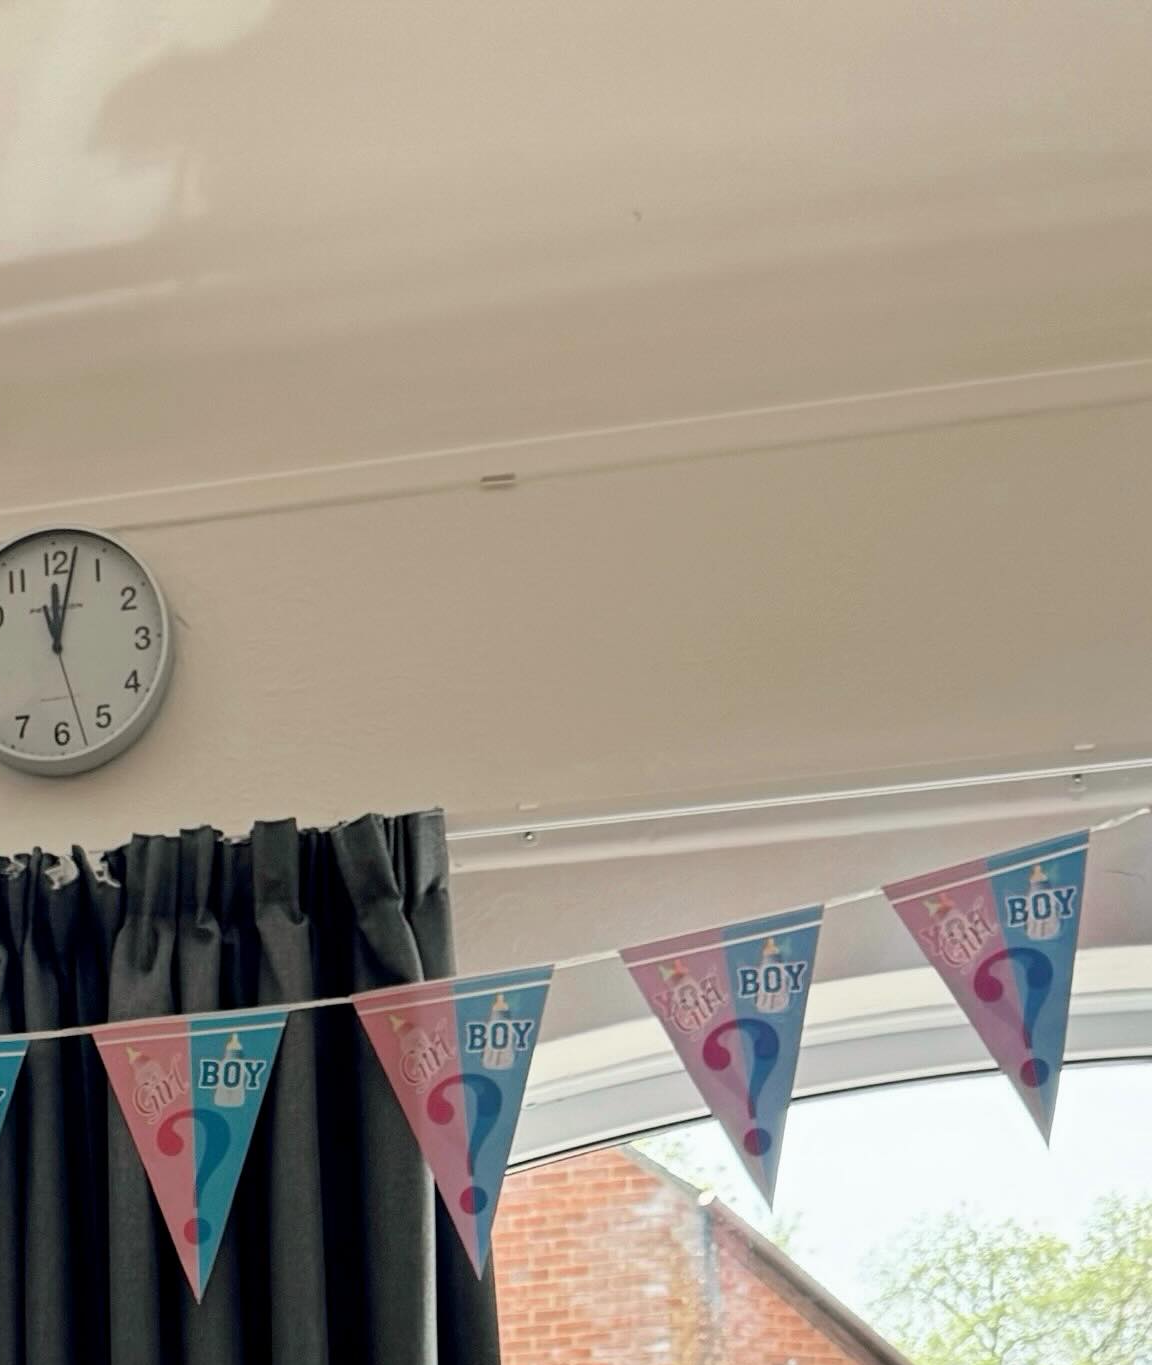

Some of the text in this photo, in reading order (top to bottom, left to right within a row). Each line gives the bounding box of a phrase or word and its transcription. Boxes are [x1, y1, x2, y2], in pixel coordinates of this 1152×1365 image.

[44, 550, 69, 577] 12
[95, 558, 101, 582] 1
[8, 568, 26, 594] 11
[120, 586, 137, 611] 2
[134, 626, 151, 650] 3
[124, 669, 141, 694] 4
[15, 715, 31, 739] 7
[95, 704, 112, 728] 5
[53, 721, 71, 746] 6
[942, 888, 1075, 968] Girl BOY
[674, 964, 805, 1035] Girl BOY
[401, 1022, 533, 1087] Girl BOY
[133, 1056, 265, 1121] Girl BOY
